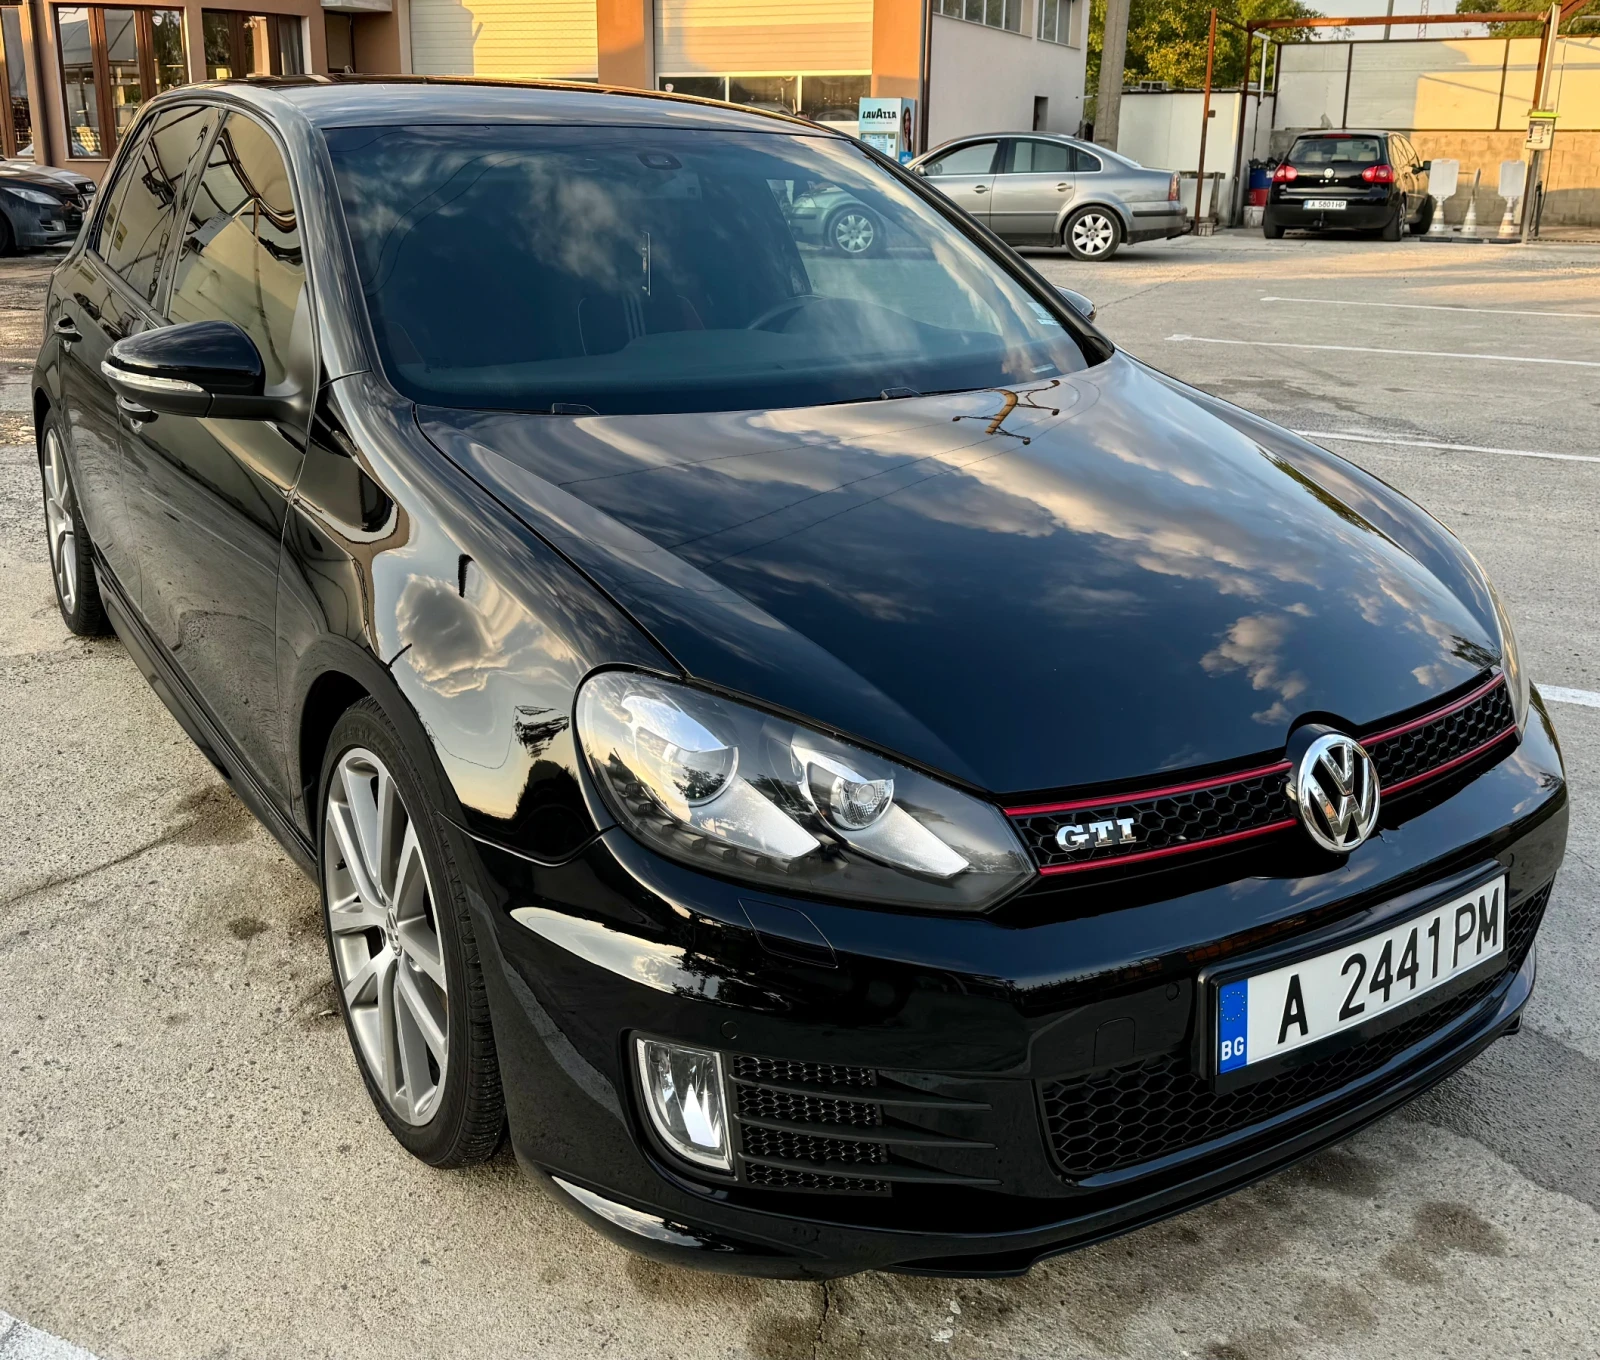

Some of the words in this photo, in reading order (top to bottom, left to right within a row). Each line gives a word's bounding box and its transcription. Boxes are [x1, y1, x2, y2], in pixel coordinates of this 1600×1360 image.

[862, 108, 897, 119] LAVAZZA
[1055, 818, 1137, 851] GTI
[1277, 974, 1308, 1045] A
[1221, 1036, 1244, 1061] BG
